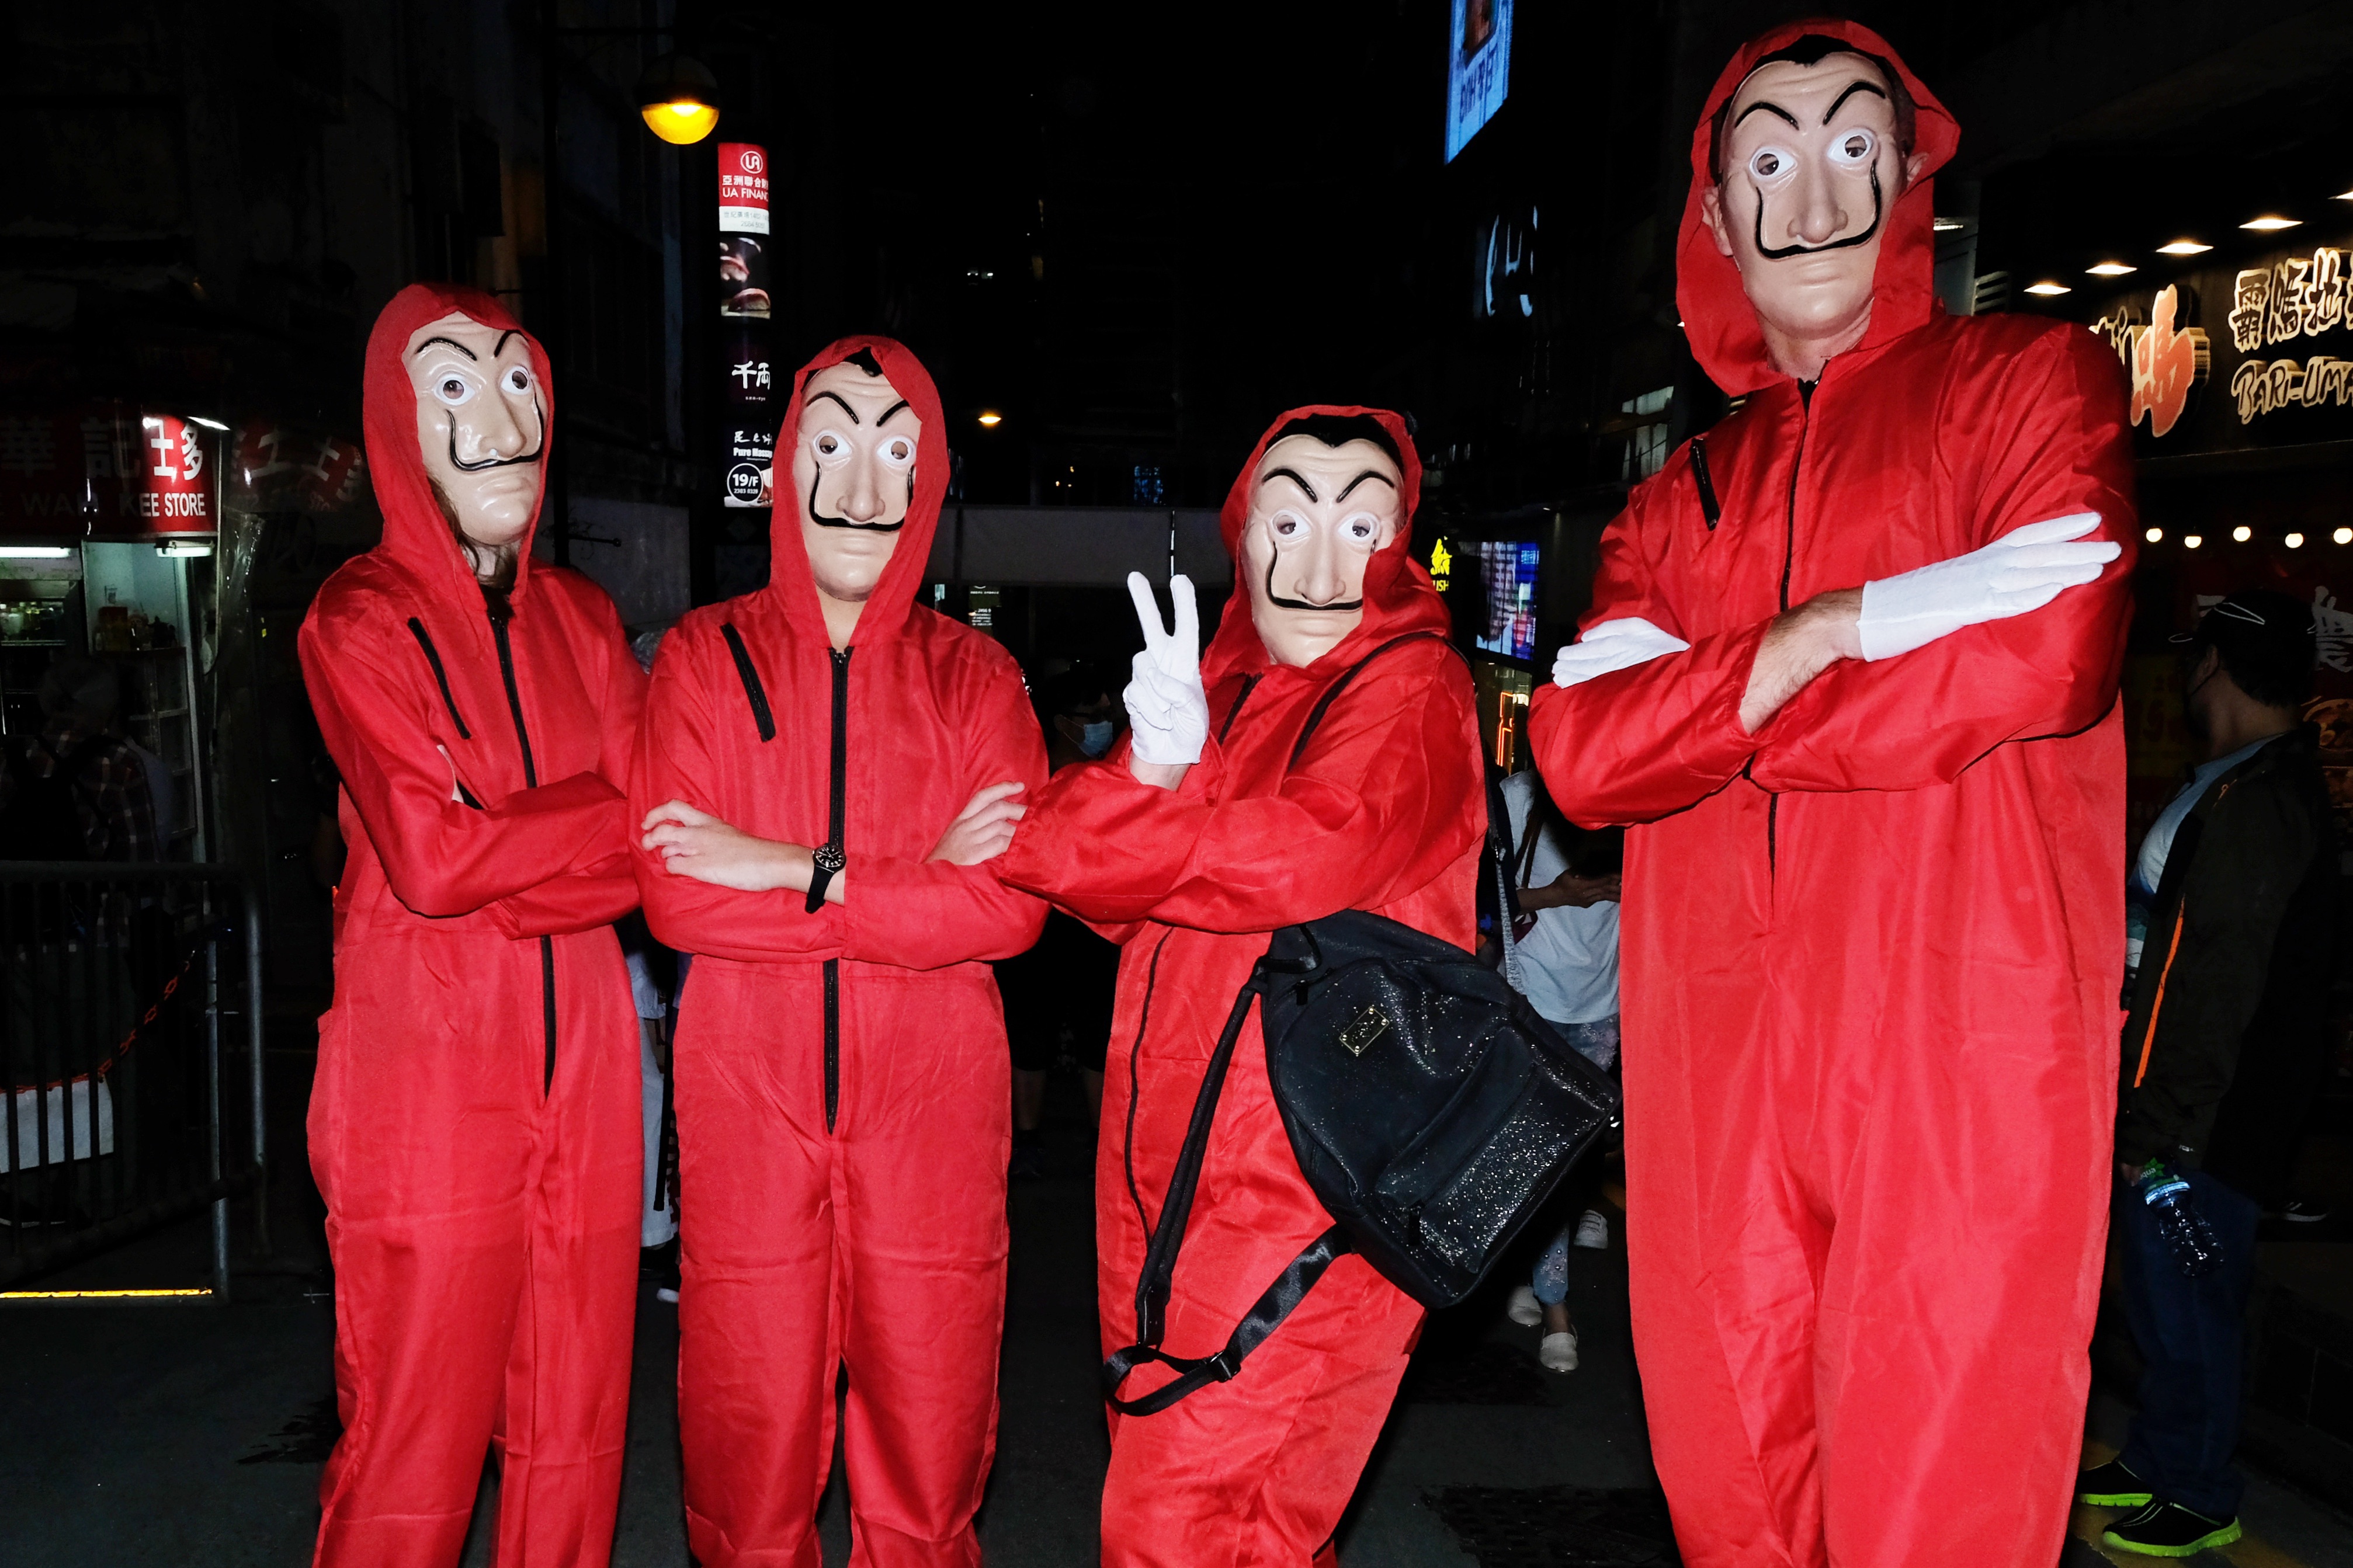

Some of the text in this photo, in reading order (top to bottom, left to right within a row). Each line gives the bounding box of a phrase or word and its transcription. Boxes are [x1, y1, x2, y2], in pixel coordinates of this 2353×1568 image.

[722, 187, 738, 197] UA
[733, 447, 751, 457] Pure
[732, 473, 759, 487] 19/F
[22, 492, 207, 517] WAH KEE STORE
